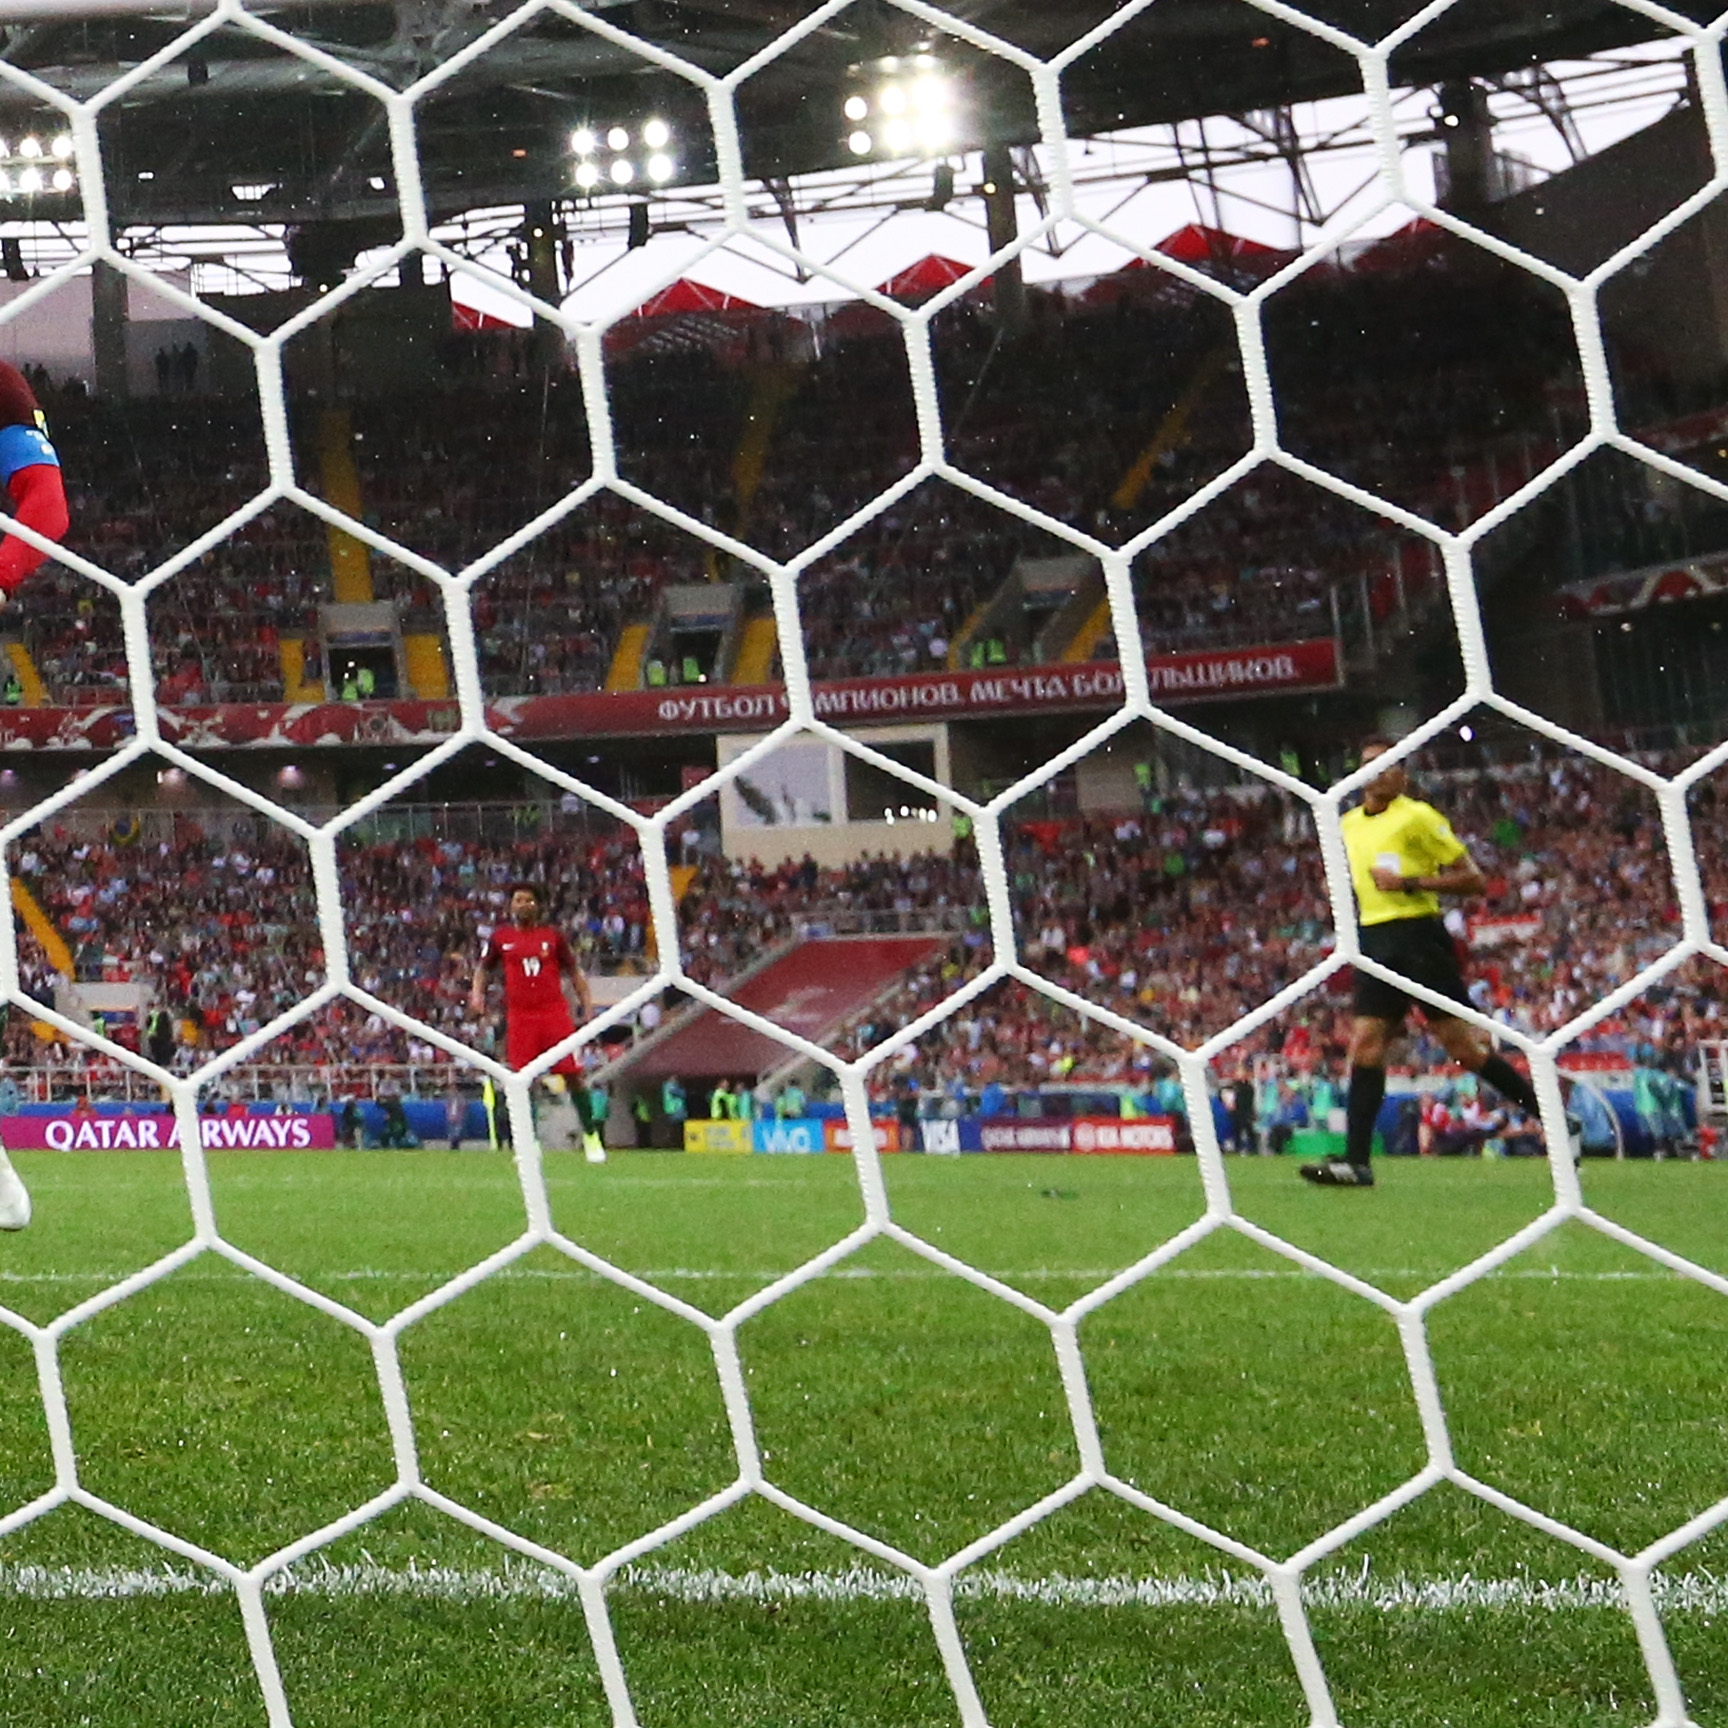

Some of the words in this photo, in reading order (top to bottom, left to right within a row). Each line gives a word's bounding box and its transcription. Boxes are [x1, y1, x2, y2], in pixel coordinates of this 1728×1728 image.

[658, 694, 774, 721] ФУТБОЛ
[778, 682, 963, 714] МПИОНОВ.
[44, 1120, 160, 1152] QATAR
[167, 1118, 311, 1148] ARWAYS
